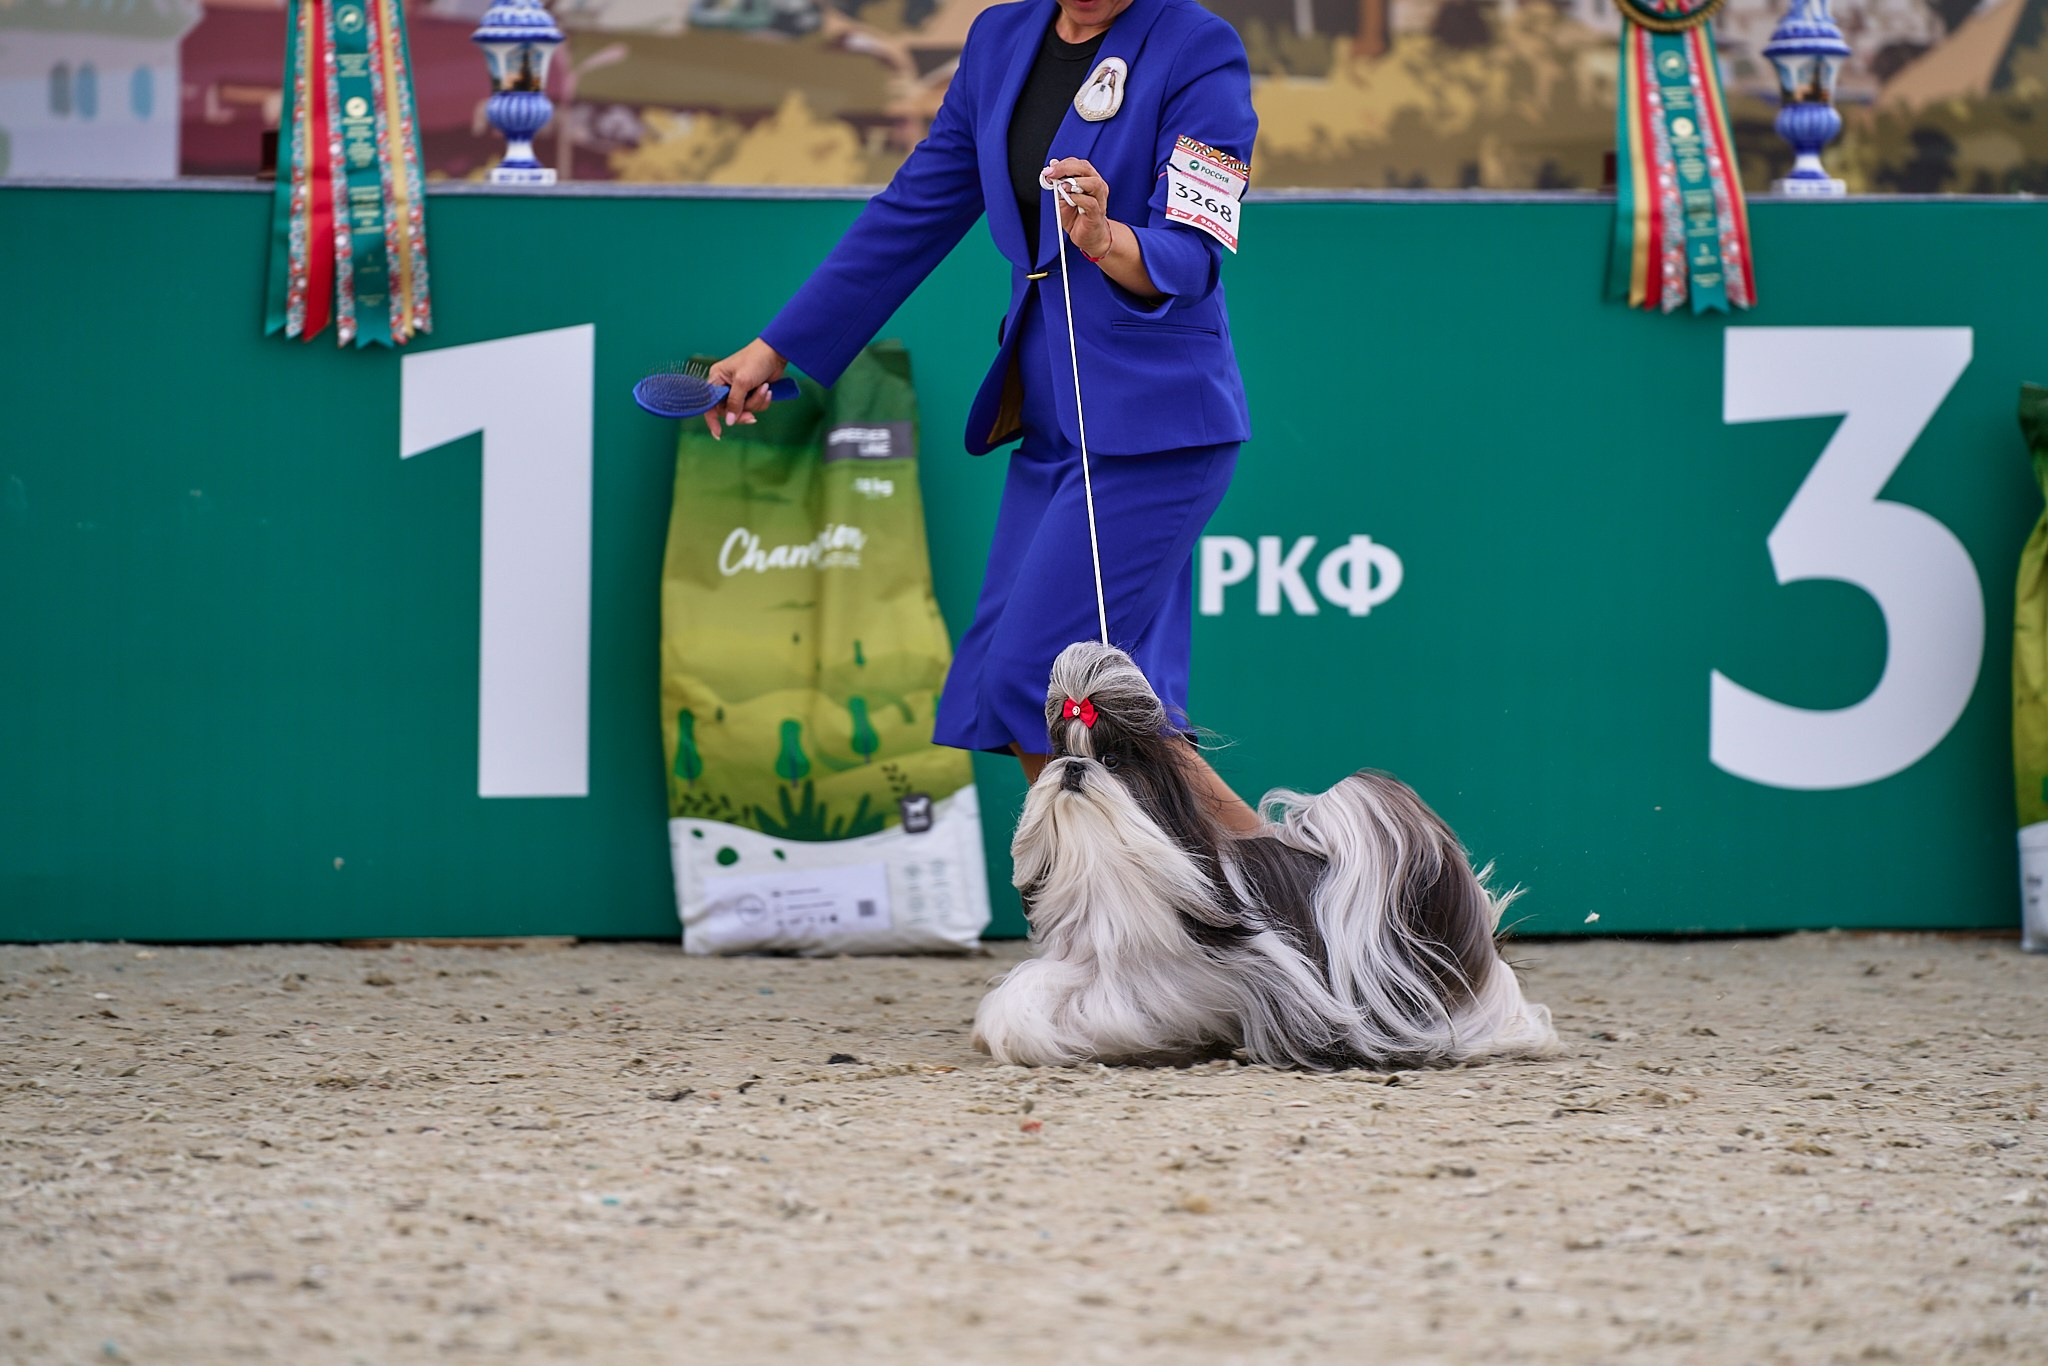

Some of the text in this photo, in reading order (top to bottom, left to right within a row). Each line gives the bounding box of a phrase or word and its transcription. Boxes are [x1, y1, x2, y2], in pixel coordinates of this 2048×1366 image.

[1175, 182, 1232, 222] 3268
[1200, 166, 1230, 183] РОССИЯ
[400, 323, 594, 798] 1
[718, 523, 868, 577] Chamion
[1199, 534, 1404, 616] РКФ
[1710, 326, 1985, 790] 3
